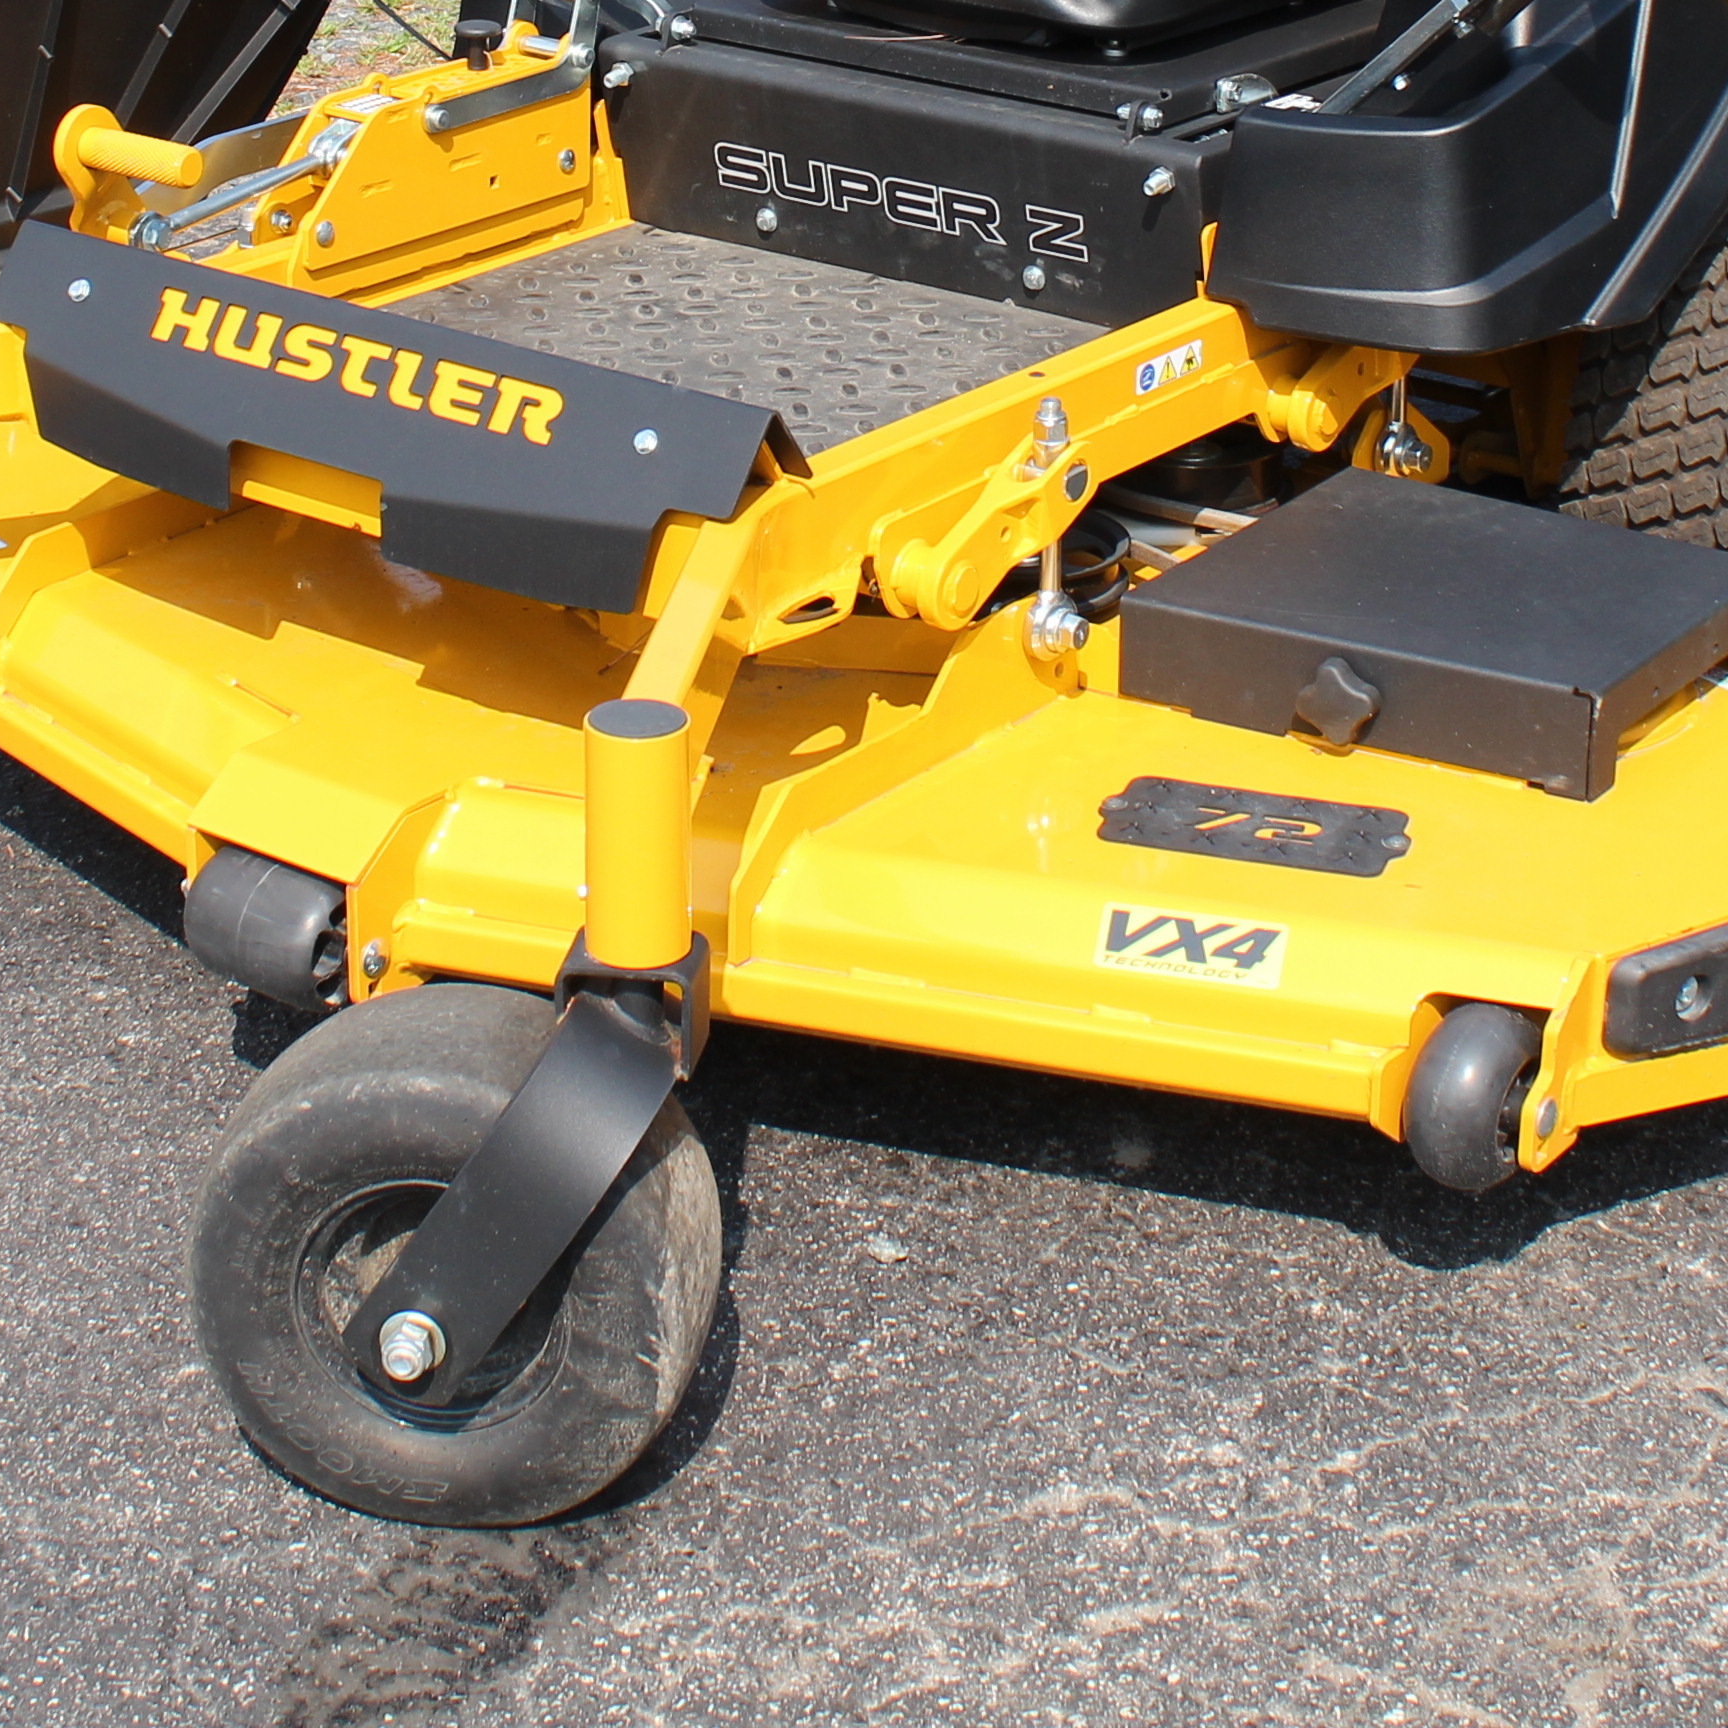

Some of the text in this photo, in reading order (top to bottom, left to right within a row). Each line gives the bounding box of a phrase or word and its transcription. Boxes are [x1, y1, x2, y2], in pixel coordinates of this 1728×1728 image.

[713, 141, 1089, 263] SUPER Z
[150, 285, 564, 447] HUSTLER
[1193, 805, 1323, 846] 72
[1103, 954, 1250, 980] TECHNOLOGY
[1105, 908, 1282, 970] VX4
